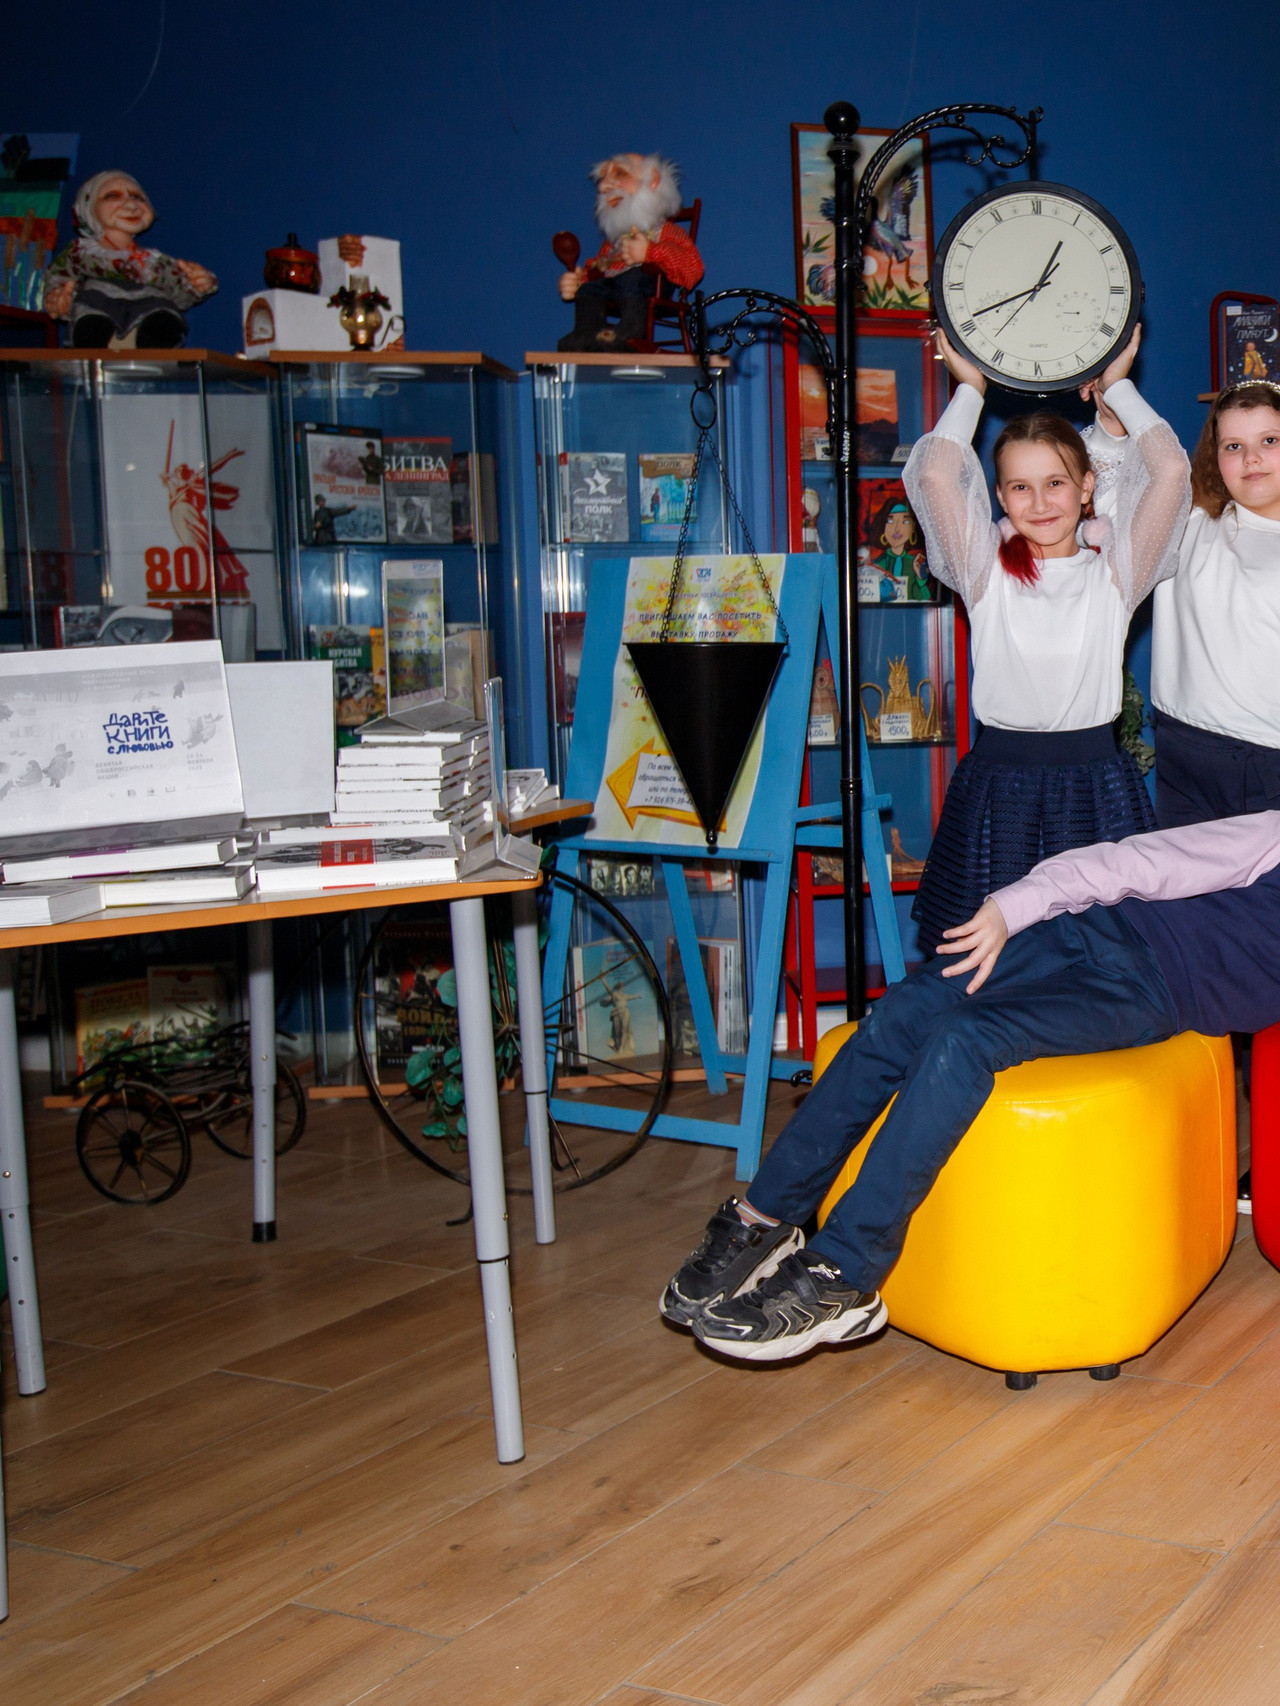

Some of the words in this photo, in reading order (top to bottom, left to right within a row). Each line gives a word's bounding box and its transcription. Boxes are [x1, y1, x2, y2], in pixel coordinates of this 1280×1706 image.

[393, 472, 449, 481] ЛЕНИНГРАД
[585, 505, 612, 514] ПОЛК
[144, 545, 203, 592] 80
[328, 647, 362, 657] КУРСКАЯ
[335, 658, 358, 667] БИТВА
[106, 725, 171, 744] КНИГИ
[638, 772, 676, 783] обращаться
